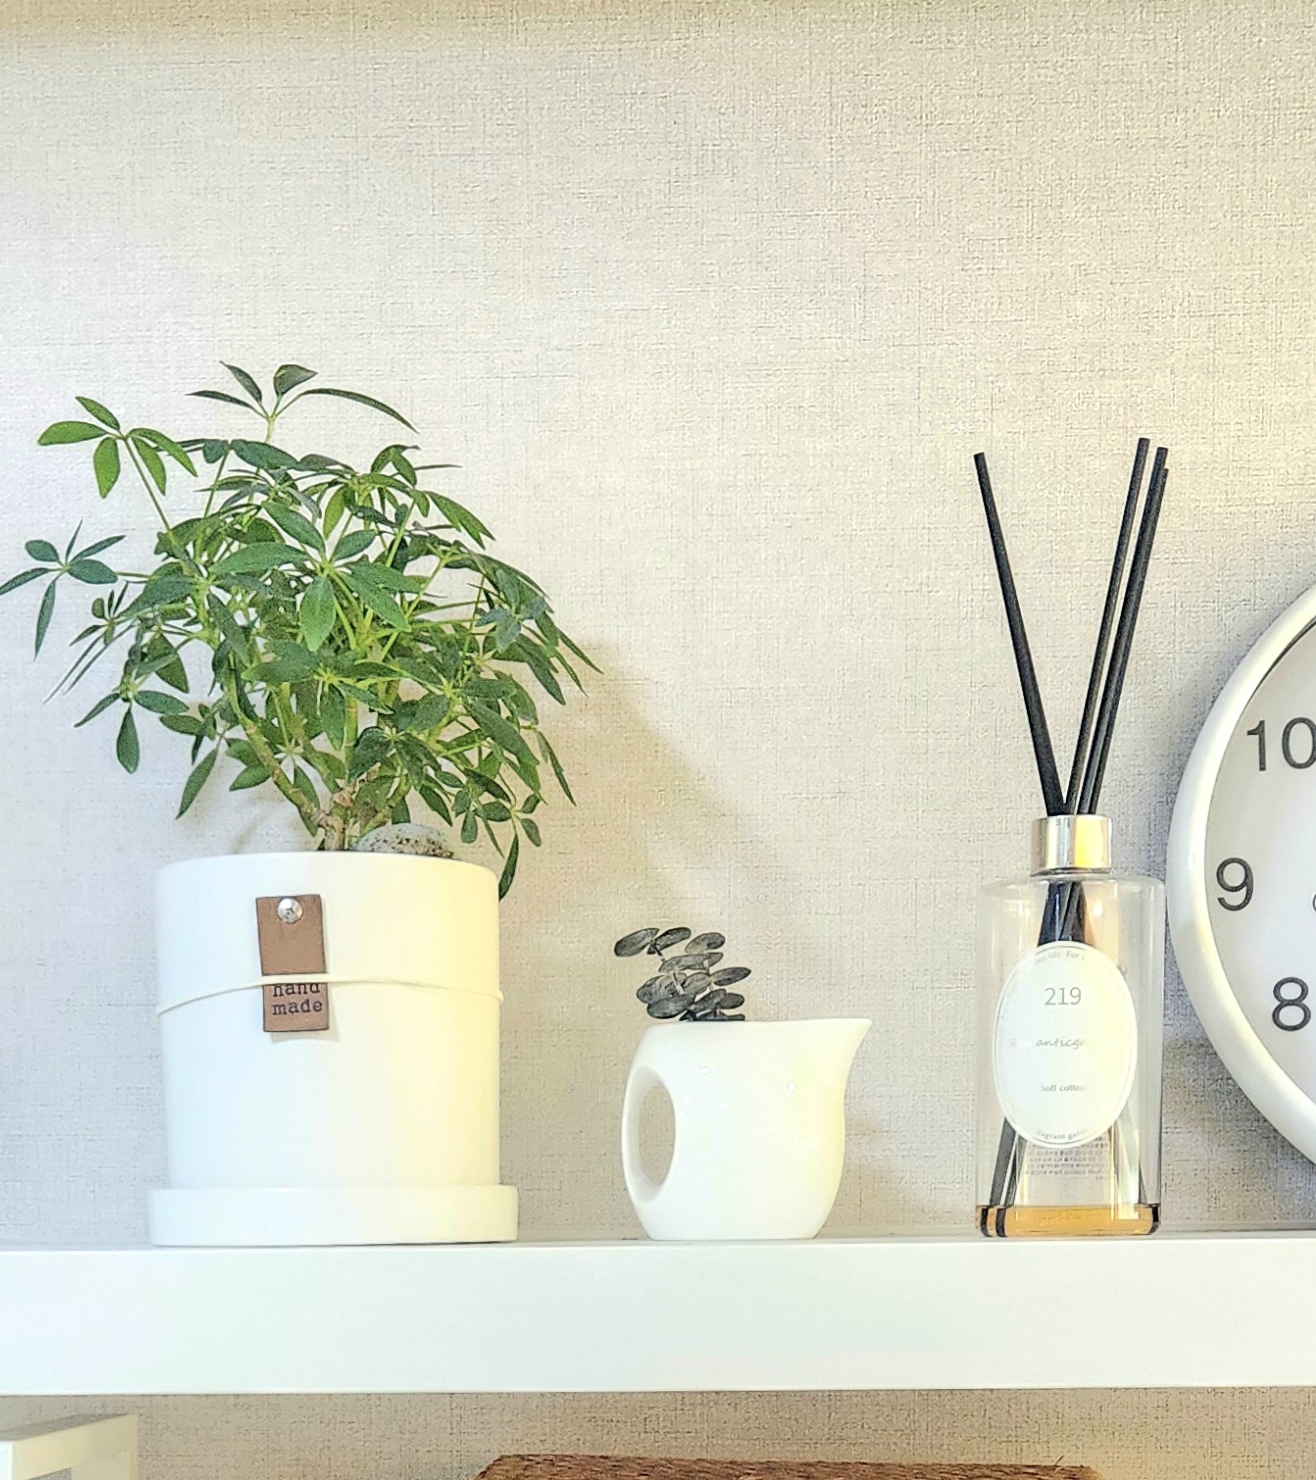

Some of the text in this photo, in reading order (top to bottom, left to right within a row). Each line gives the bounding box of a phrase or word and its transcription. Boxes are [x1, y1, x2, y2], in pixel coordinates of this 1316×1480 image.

[1216, 858, 1254, 911] 9
[273, 983, 320, 997] hand
[1044, 986, 1082, 1006] 219
[272, 999, 323, 1015] made
[1273, 978, 1311, 1031] 8
